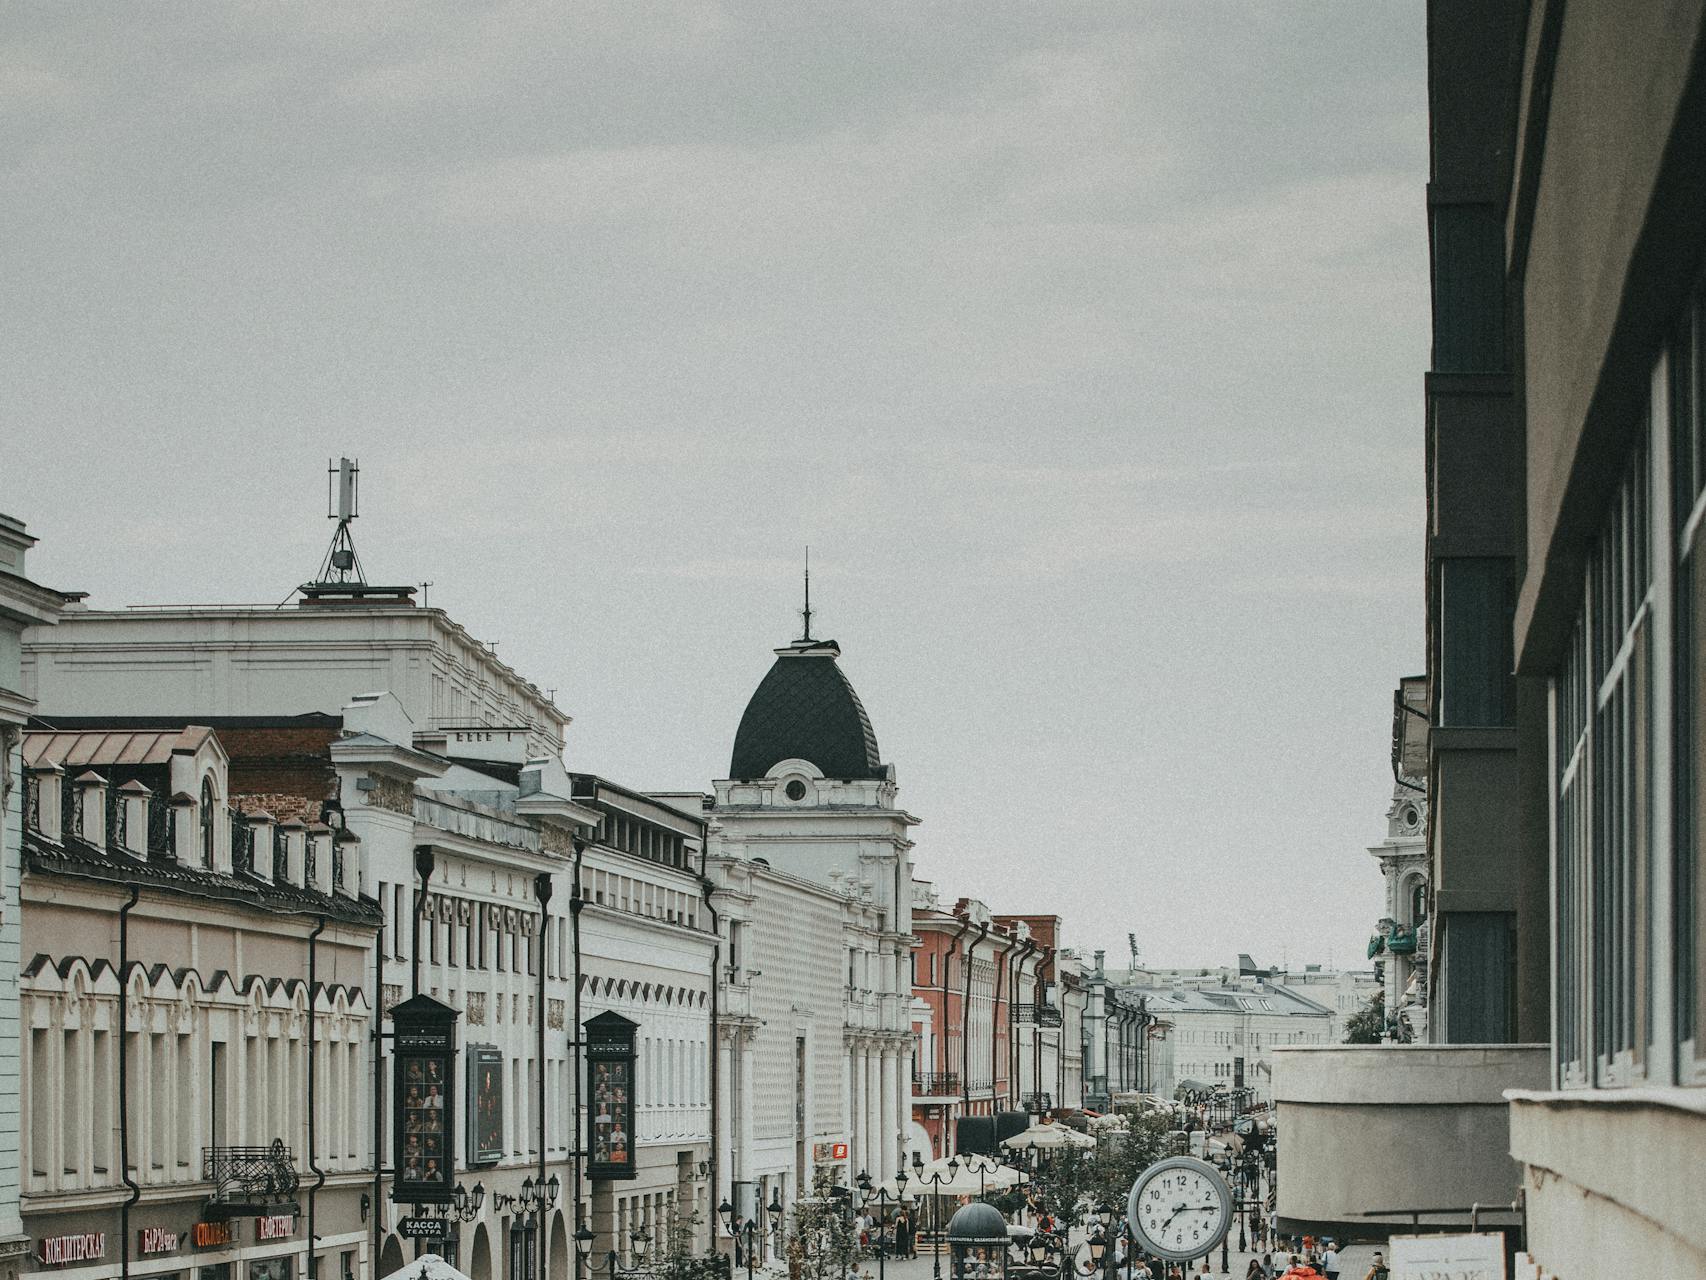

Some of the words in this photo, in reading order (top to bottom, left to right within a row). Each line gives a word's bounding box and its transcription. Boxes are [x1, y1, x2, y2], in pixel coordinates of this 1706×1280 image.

[1162, 1180, 1171, 1189] 11
[1176, 1176, 1187, 1186] 12
[1194, 1180, 1199, 1189] 1
[1150, 1190, 1160, 1200] 10
[1205, 1191, 1211, 1201] 2
[1145, 1204, 1152, 1214] 9
[406, 1221, 441, 1229] КАССА
[1150, 1219, 1157, 1230] 8
[1203, 1221, 1209, 1231] 4
[1161, 1229, 1167, 1239] 7
[1176, 1234, 1183, 1244] 6
[1193, 1230, 1199, 1240] 5
[144, 1229, 158, 1253] БАР
[164, 1232, 177, 1250] часа
[45, 1232, 105, 1266] КОНДИТЕРСКАЯ
